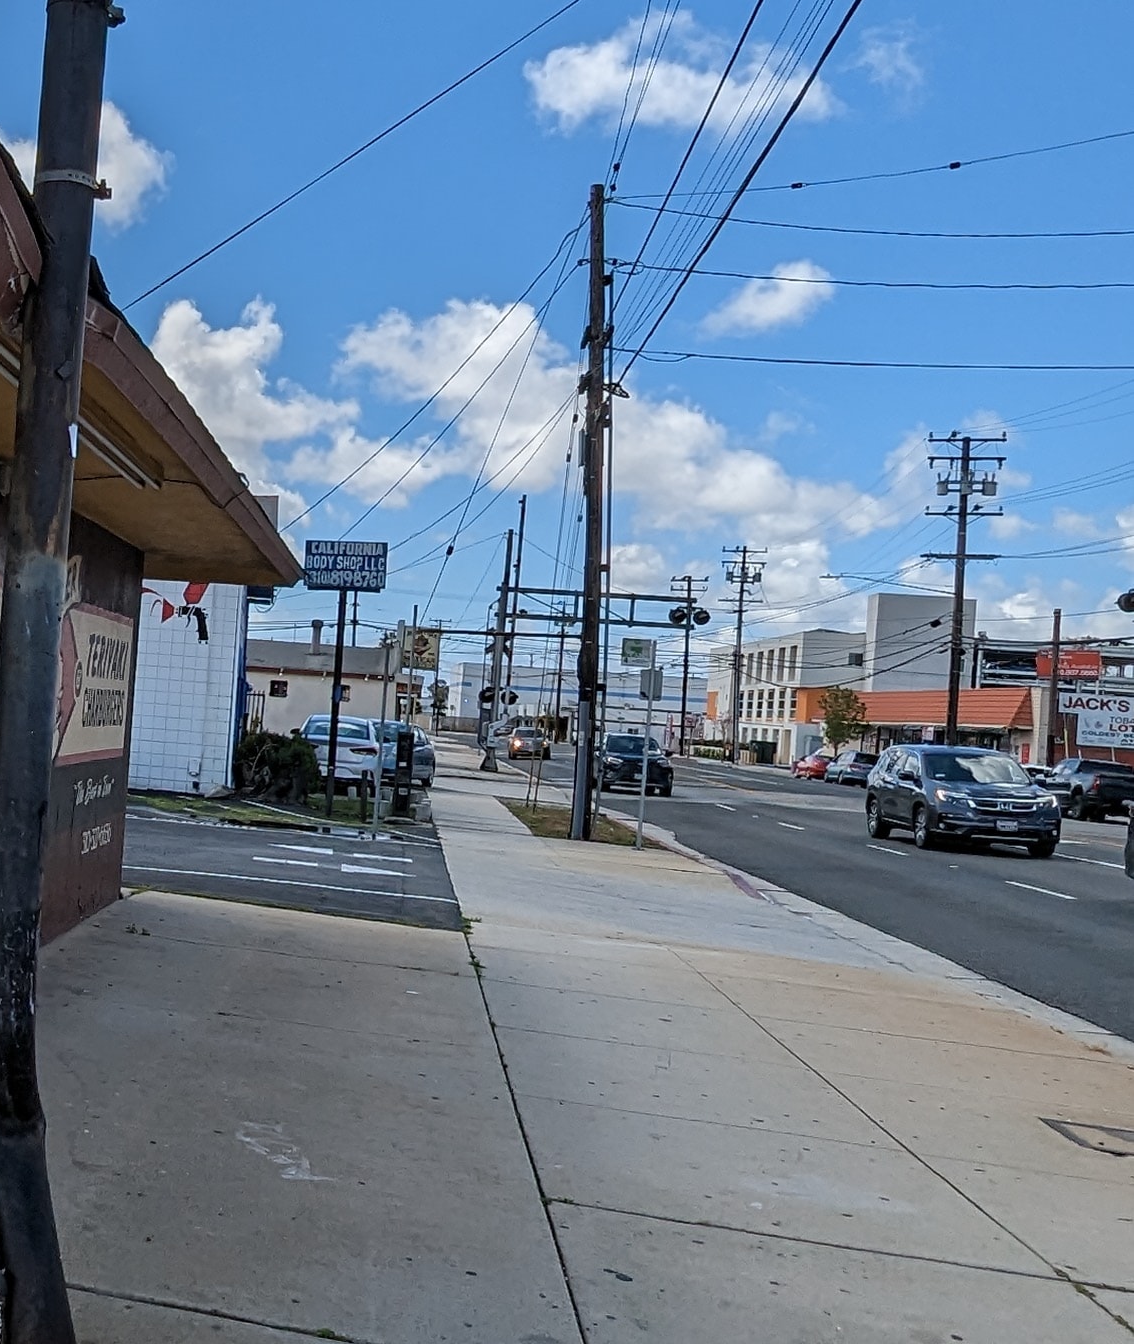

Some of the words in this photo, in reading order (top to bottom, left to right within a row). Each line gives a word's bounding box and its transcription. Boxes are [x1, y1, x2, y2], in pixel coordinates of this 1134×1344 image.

[311, 542, 384, 556] CALIFORNIA
[306, 556, 334, 570] BODY
[336, 557, 363, 571] SHOP
[86, 633, 129, 681] TERIYAKI
[1063, 695, 1131, 713] JACK'S
